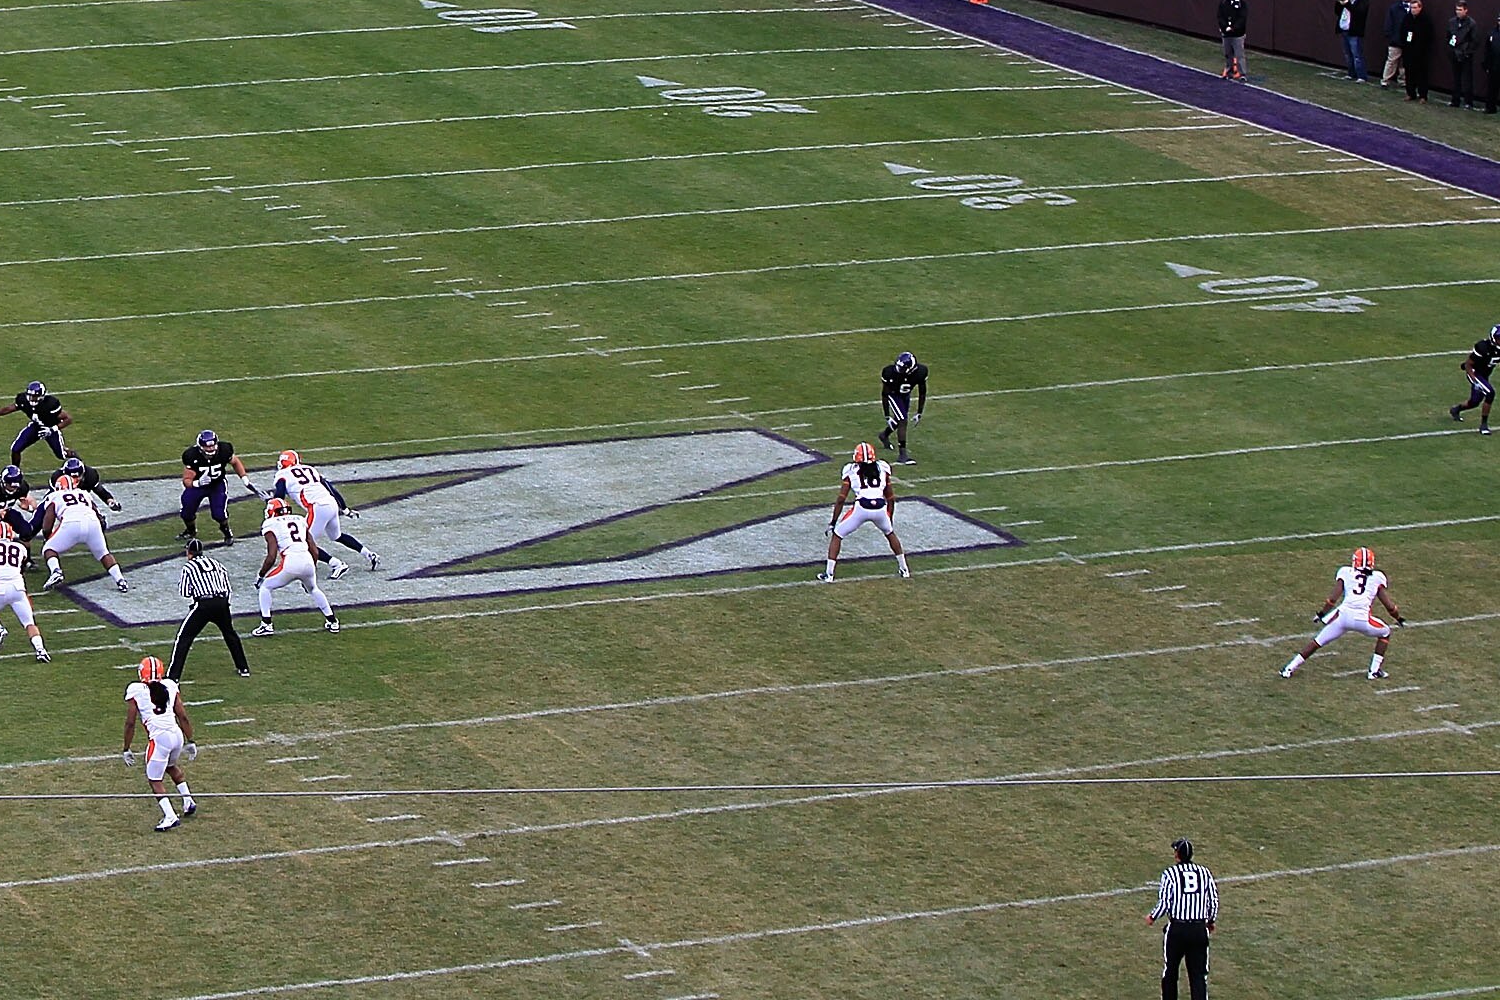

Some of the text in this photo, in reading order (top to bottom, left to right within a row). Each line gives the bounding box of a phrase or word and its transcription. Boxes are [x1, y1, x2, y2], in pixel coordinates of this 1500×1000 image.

[290, 467, 320, 486] 97
[62, 493, 90, 507] 94
[287, 521, 302, 542] 2
[1351, 573, 1368, 596] 3
[1182, 871, 1198, 894] B
